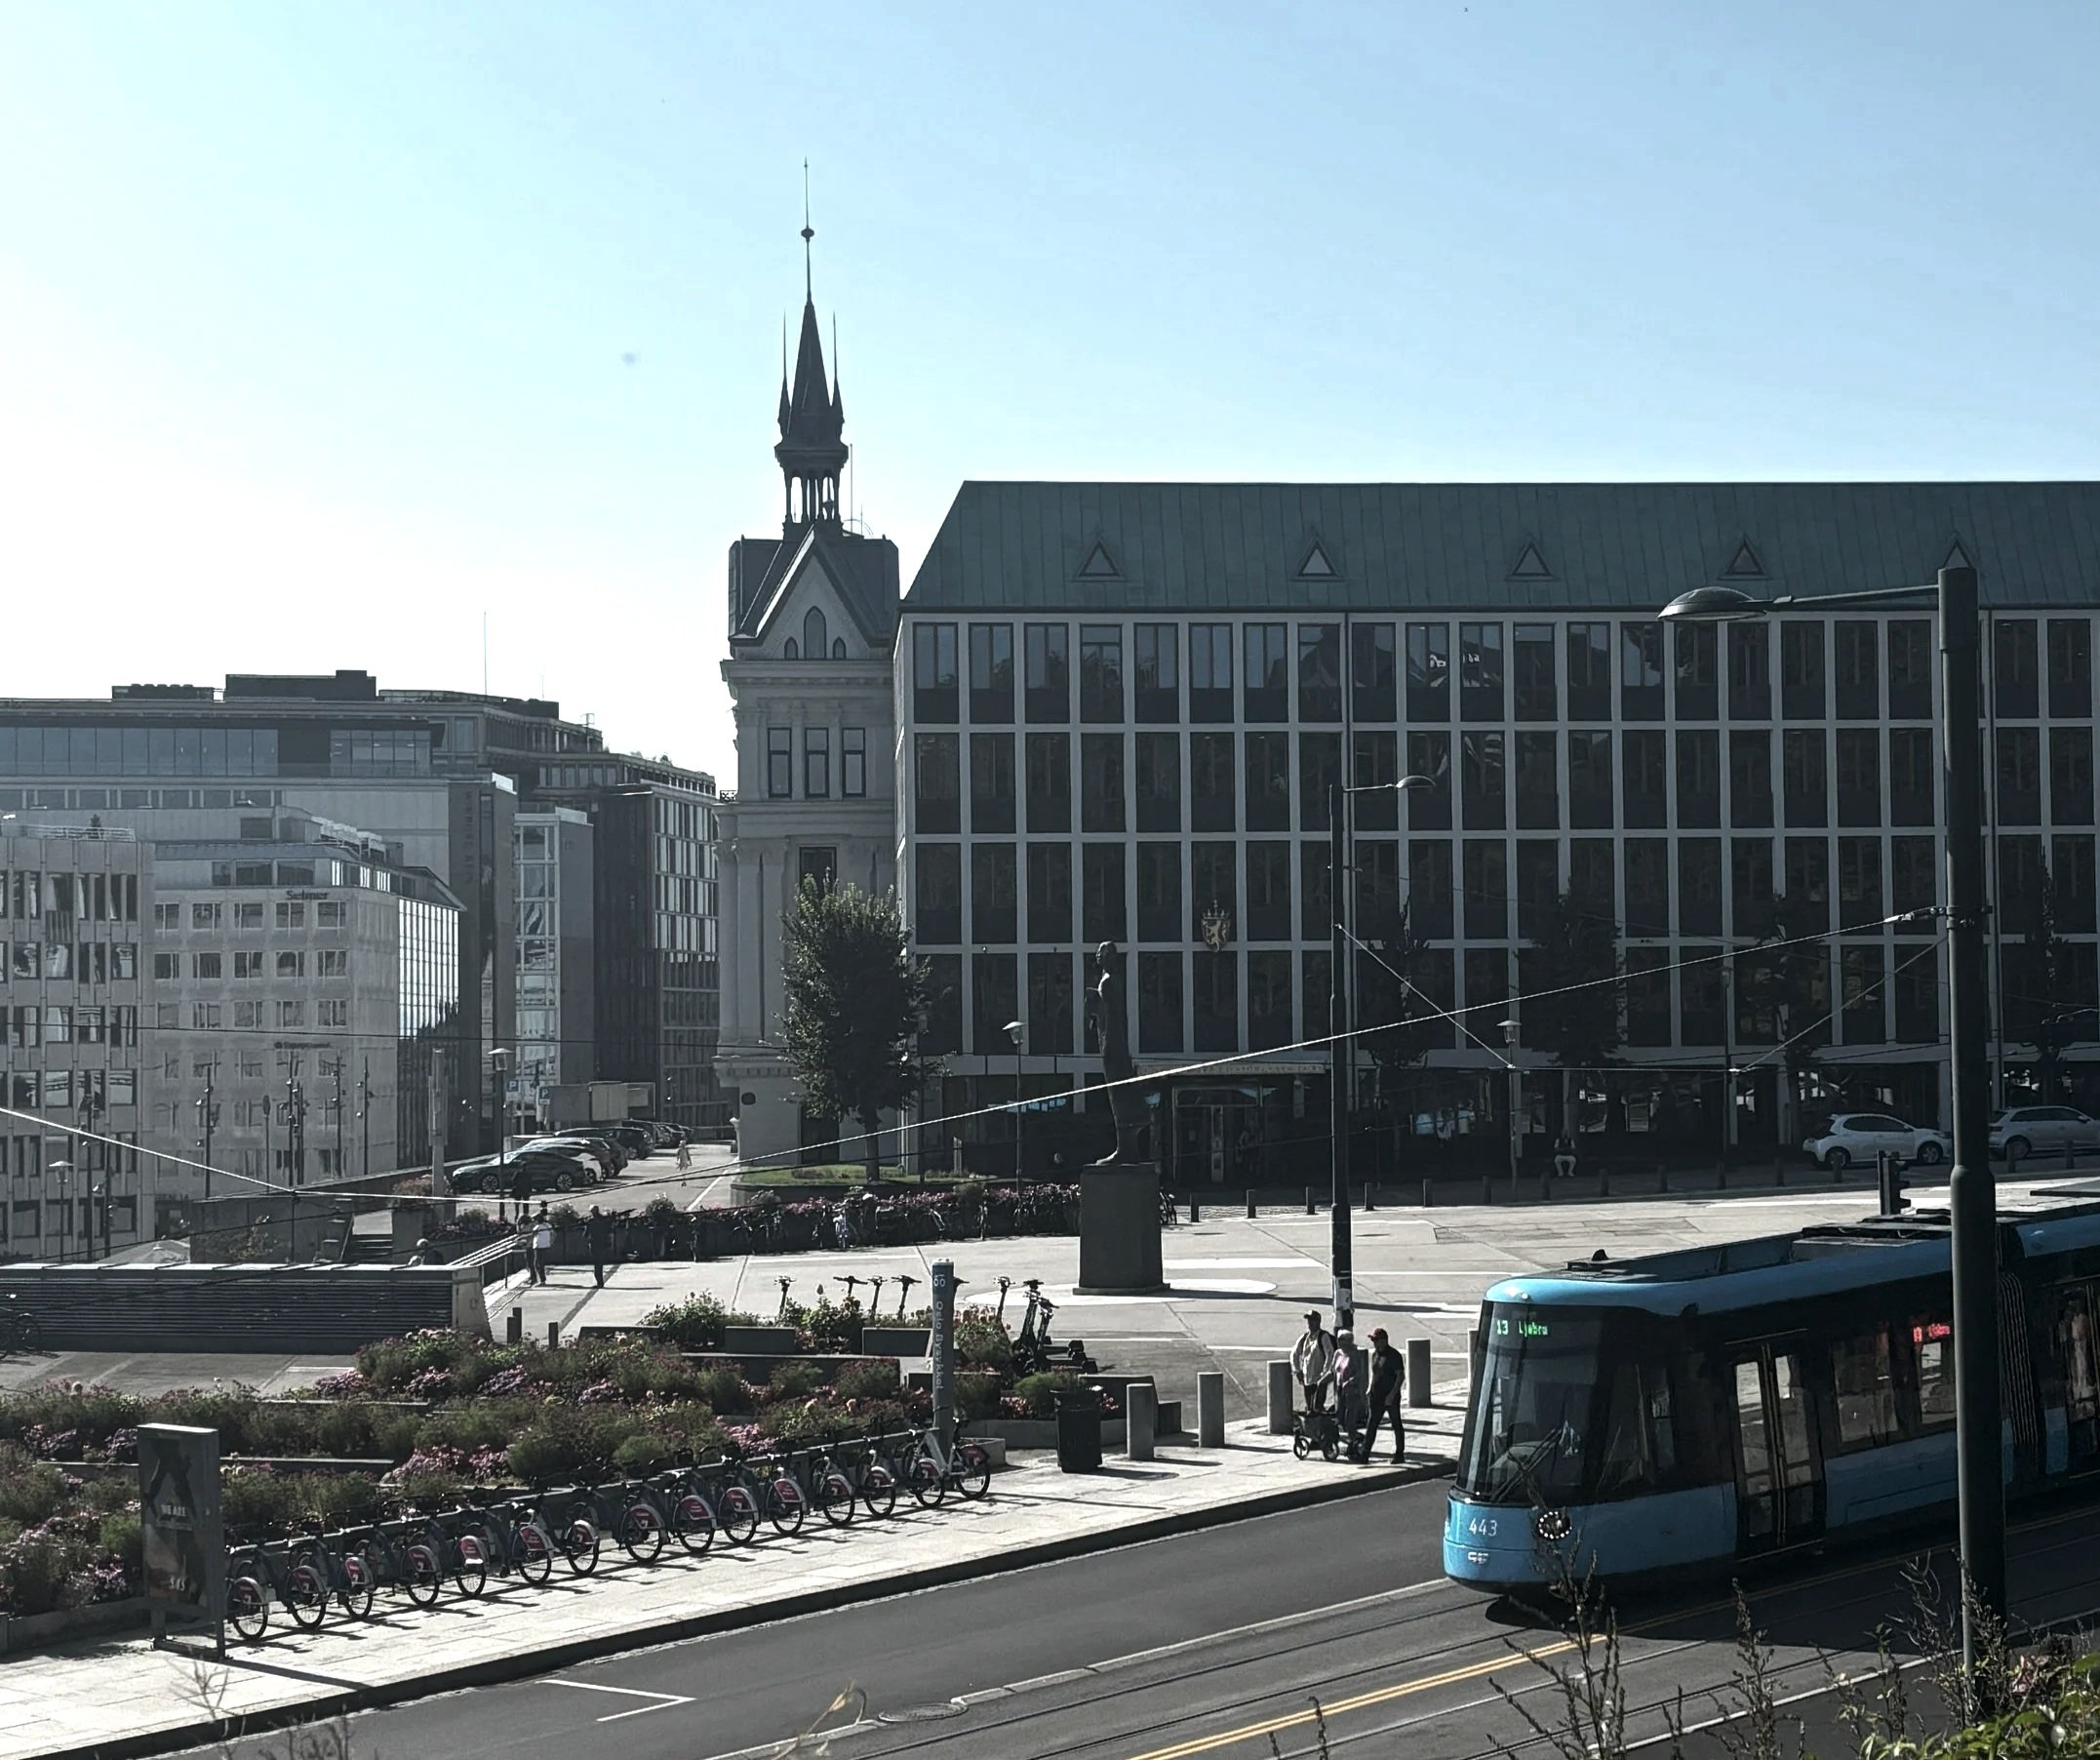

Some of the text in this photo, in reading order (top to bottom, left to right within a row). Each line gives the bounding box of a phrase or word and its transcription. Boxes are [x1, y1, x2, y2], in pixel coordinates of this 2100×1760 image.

[1496, 1319, 1509, 1335] 13
[934, 1300, 944, 1389] Oslo Bysykkel
[1468, 1516, 1498, 1538] 443
